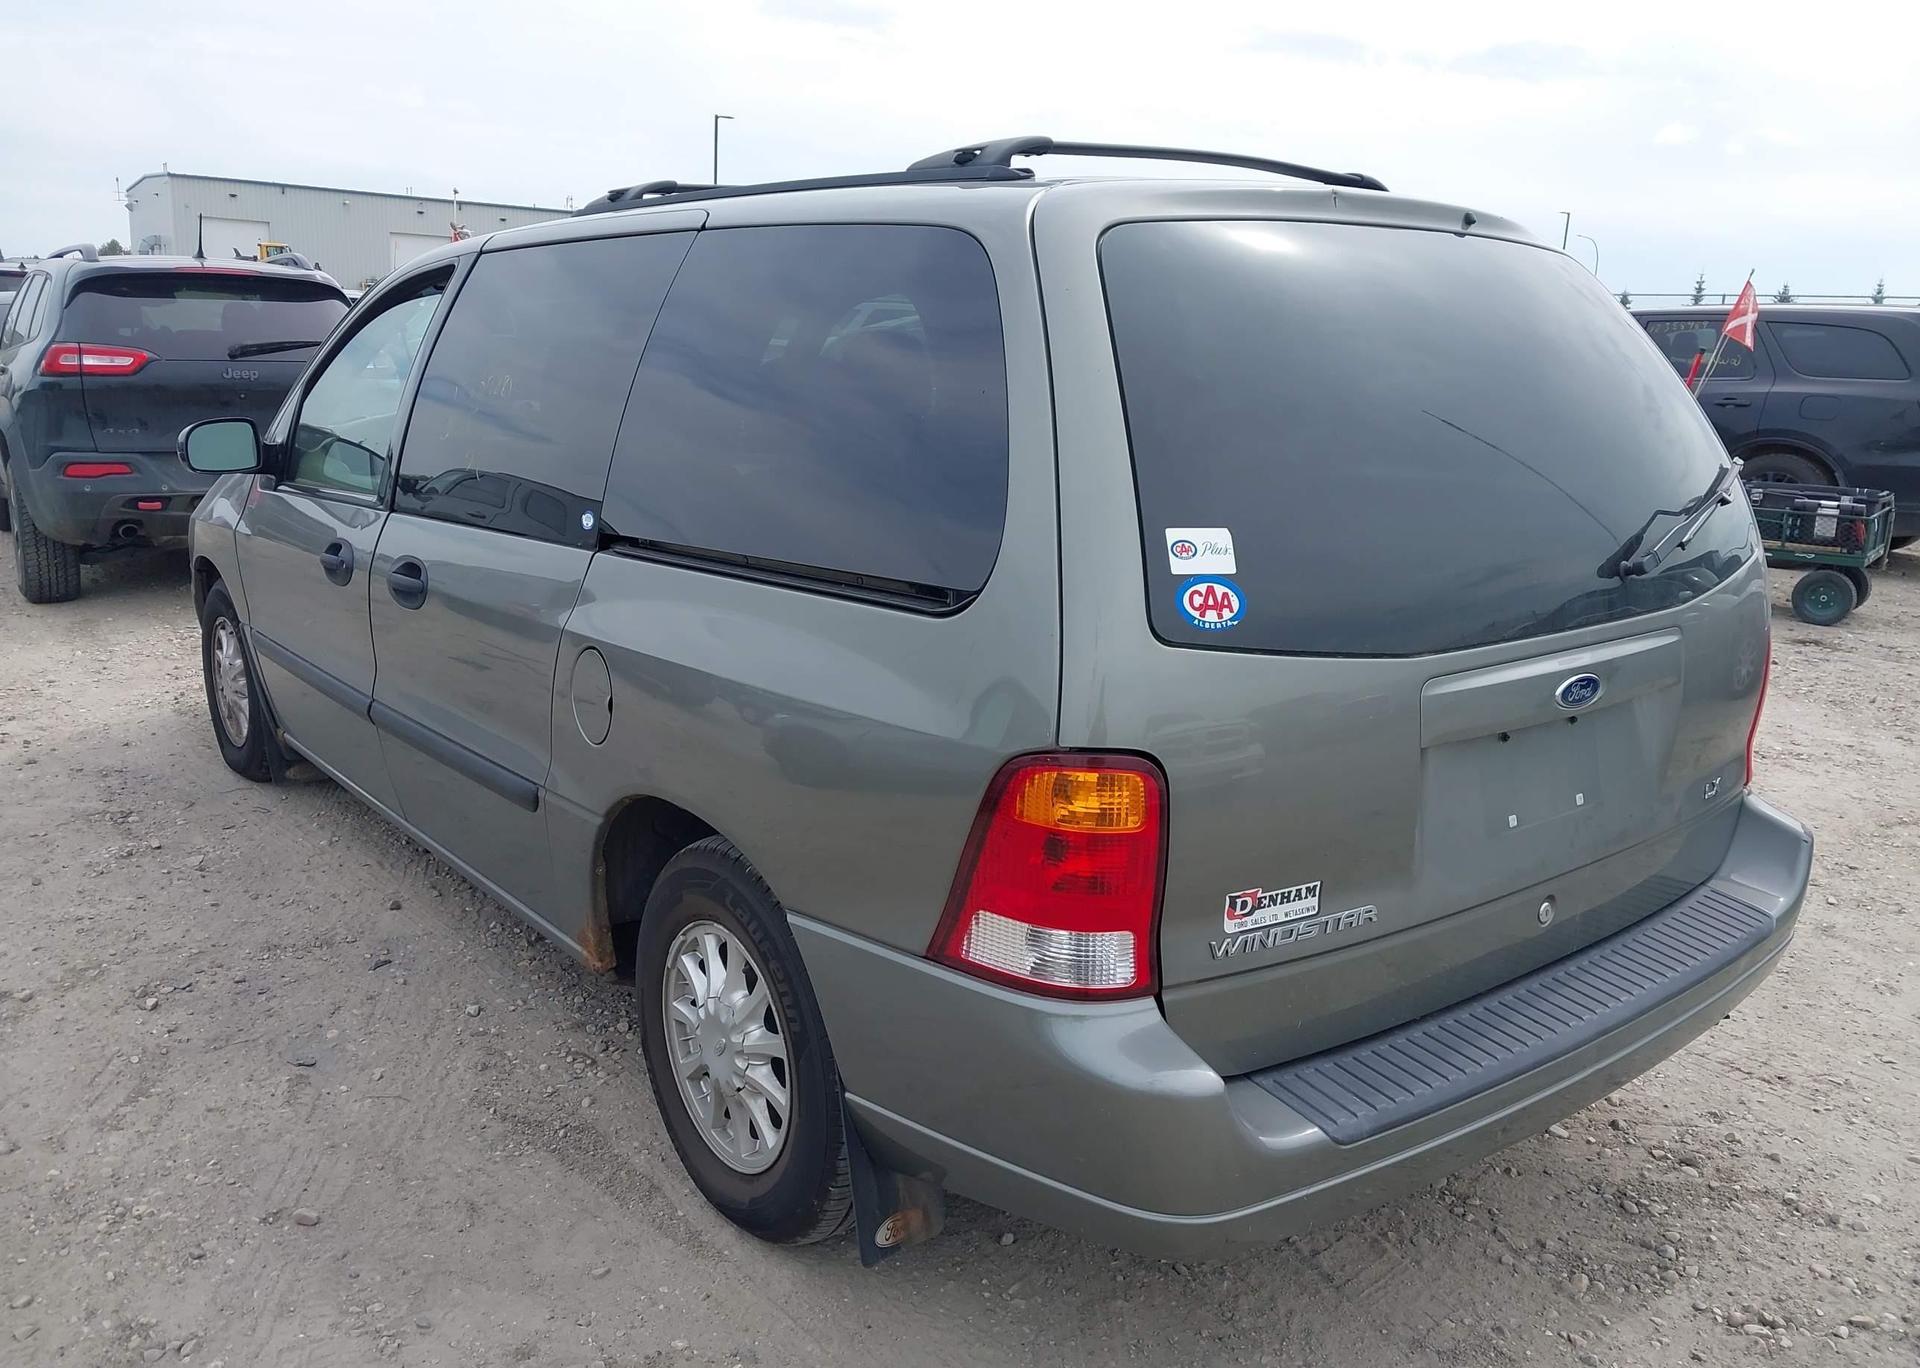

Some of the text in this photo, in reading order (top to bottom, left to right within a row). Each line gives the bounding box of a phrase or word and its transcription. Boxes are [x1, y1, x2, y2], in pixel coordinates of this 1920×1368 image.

[222, 367, 259, 381] Jeep
[1175, 540, 1229, 558] CAA Plus
[1188, 585, 1235, 620] CAA
[1193, 618, 1233, 629] ALBERTA
[1568, 680, 1594, 702] Ford
[1703, 776, 1722, 800] LX
[1234, 884, 1319, 916] DENHAM
[1233, 920, 1248, 931] FORD
[1250, 915, 1267, 926] SALES
[1283, 904, 1317, 919] WETASKIWIN
[1209, 904, 1379, 961] WINDSTAR
